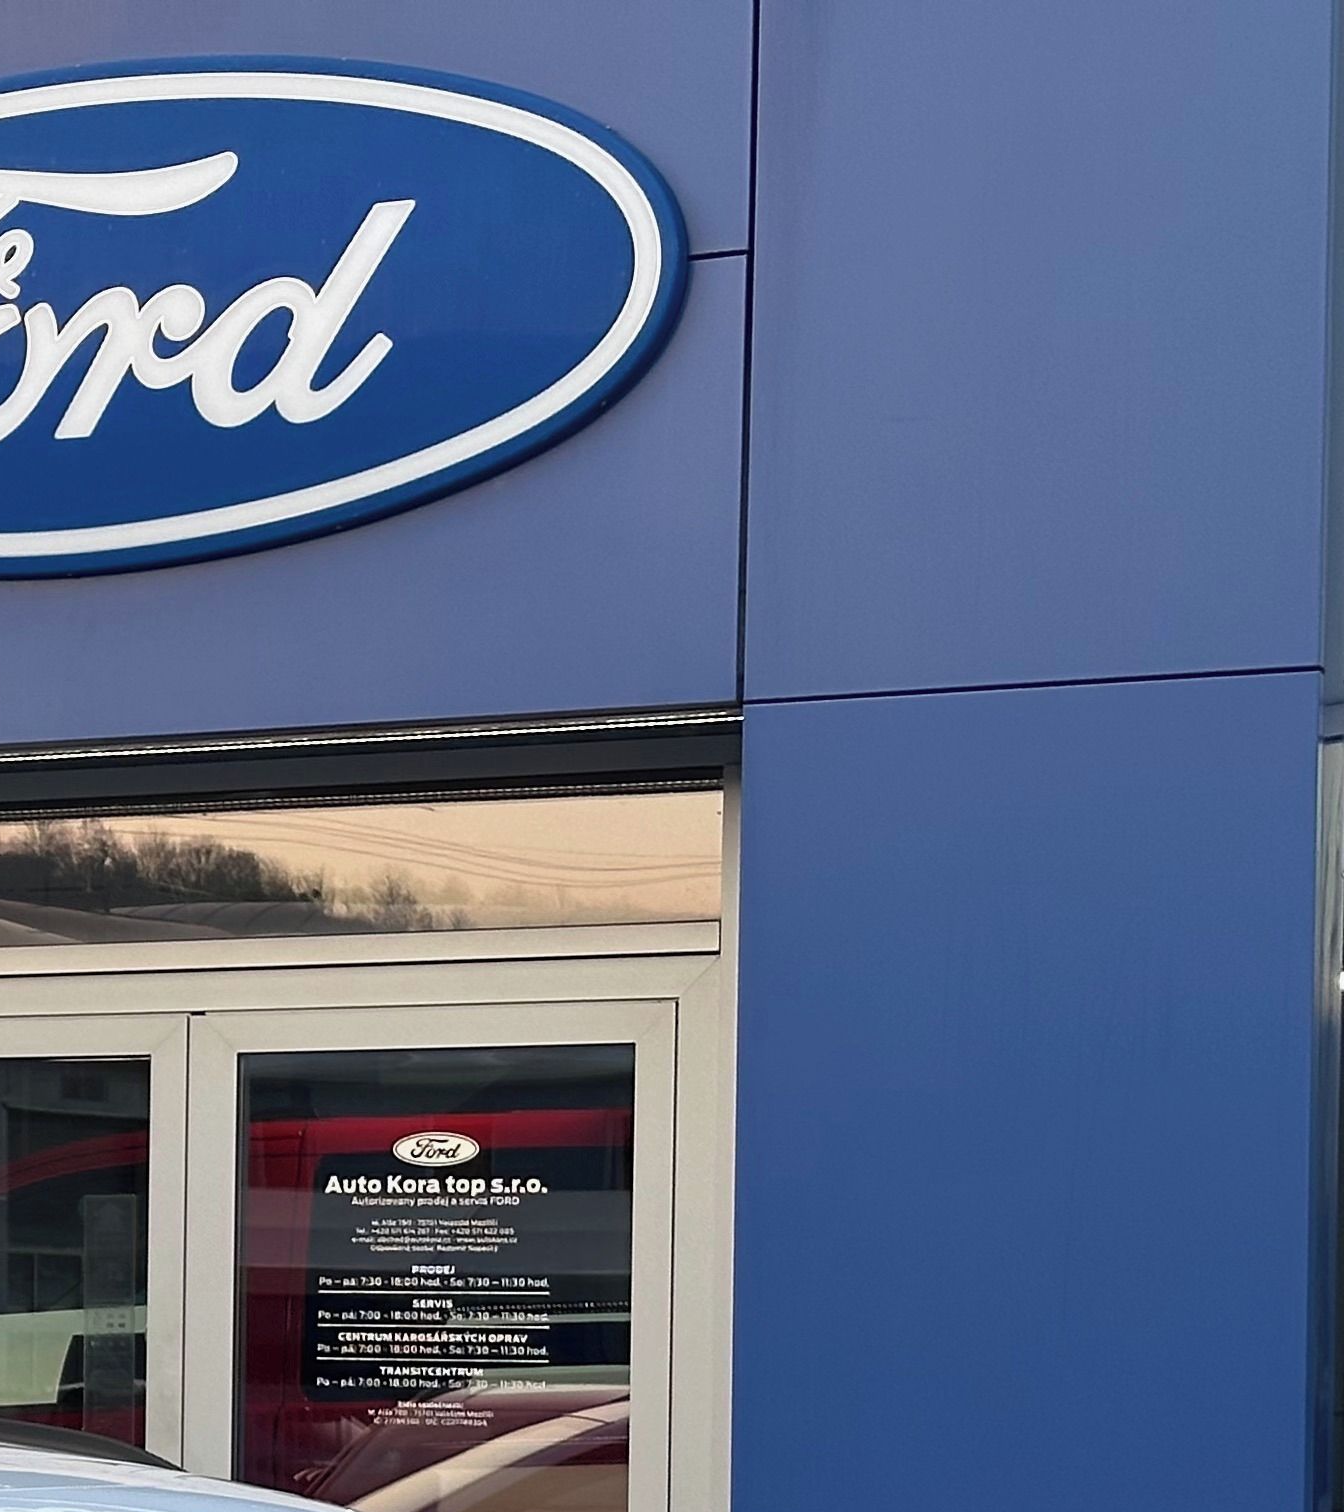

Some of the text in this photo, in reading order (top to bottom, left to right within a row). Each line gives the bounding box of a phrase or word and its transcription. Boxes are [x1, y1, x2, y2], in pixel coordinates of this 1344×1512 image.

[324, 1175, 548, 1197] Auto Kora top s.r.o.
[490, 1196, 520, 1206] FORD
[412, 1265, 455, 1275] PRODEJ
[319, 1276, 332, 1286] Po
[412, 1299, 453, 1308] SERVIS
[318, 1310, 331, 1319] Po
[338, 1332, 392, 1342] CENTRUM
[488, 1333, 528, 1343] OPRAV
[379, 1366, 484, 1376] TRANSITCENTRUM
